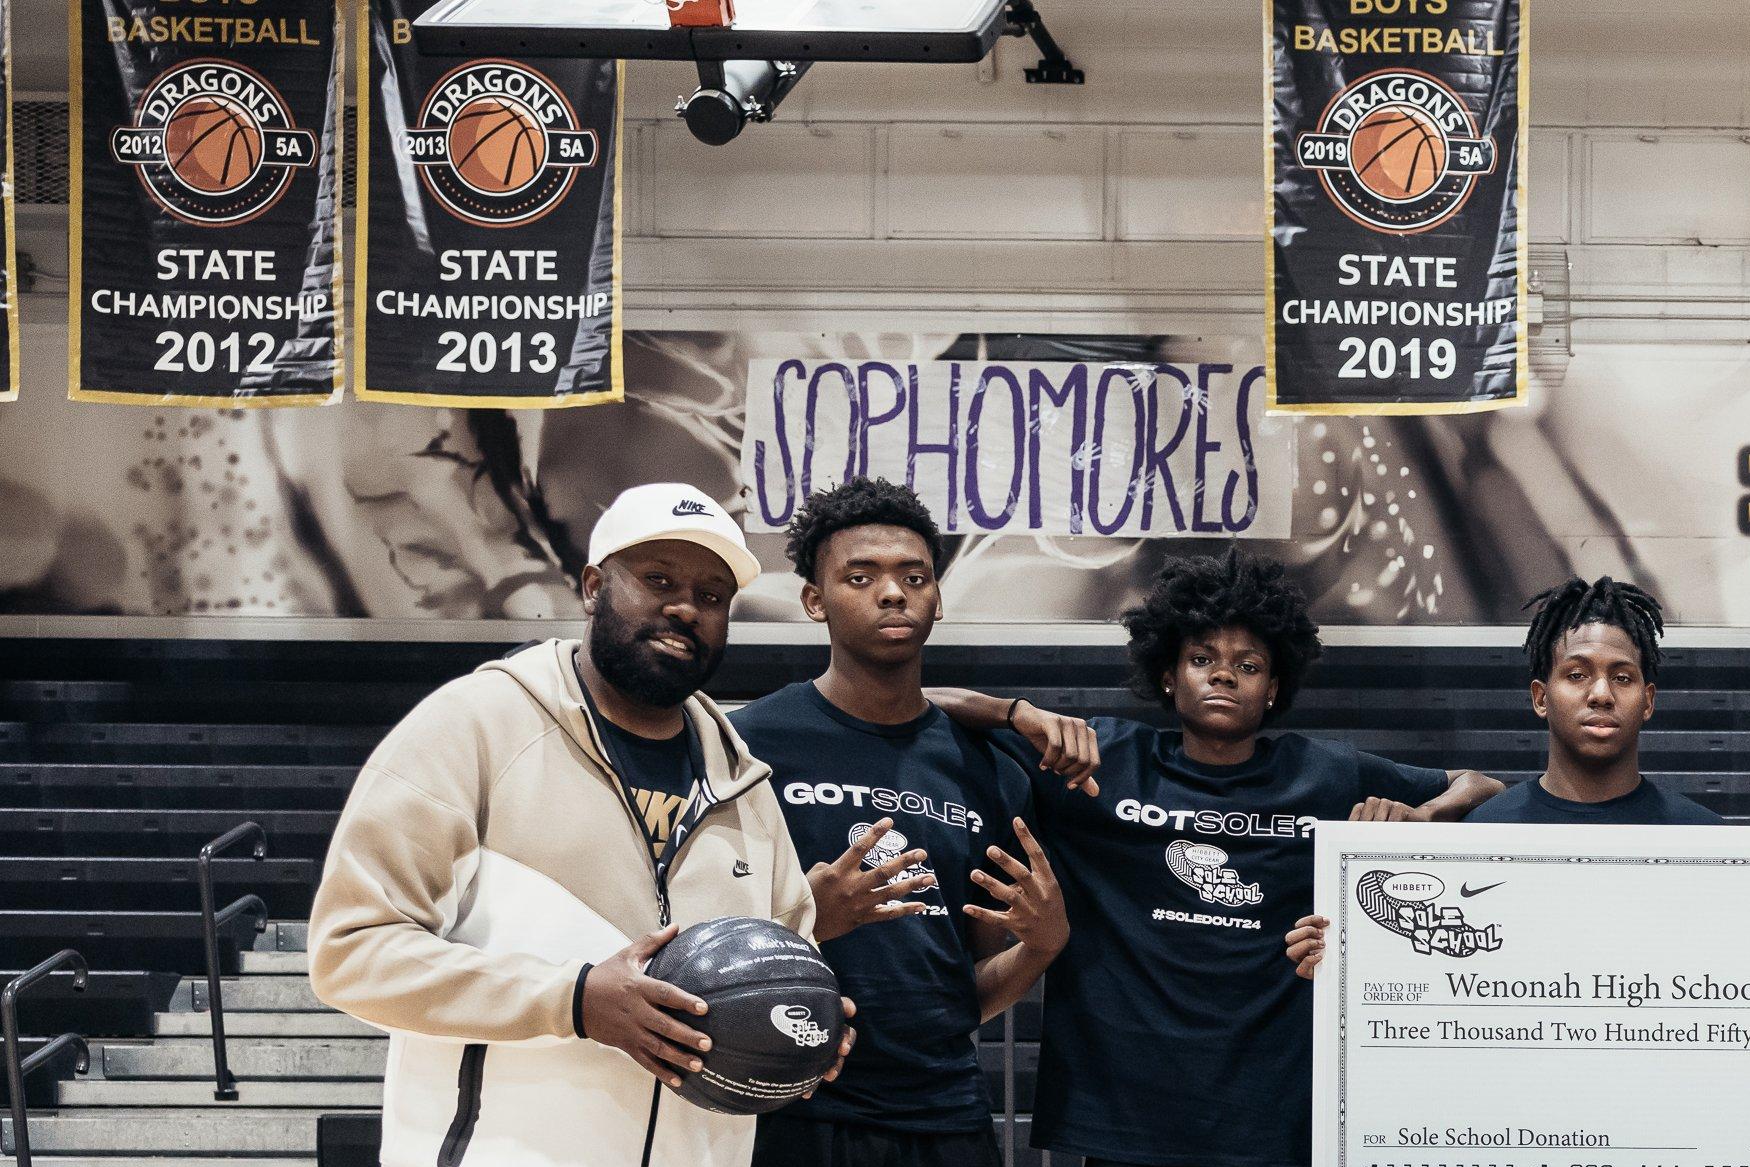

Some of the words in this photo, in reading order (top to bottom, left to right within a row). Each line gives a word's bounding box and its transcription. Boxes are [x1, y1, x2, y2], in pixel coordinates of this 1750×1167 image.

[107, 15, 320, 46] BASKETBALL
[1294, 25, 1504, 56] BASKETBALL
[148, 68, 278, 123] DRAGONS
[430, 69, 563, 125] DRAGONS
[1333, 79, 1463, 133] DRAGONS
[119, 135, 162, 154] 2012
[275, 137, 302, 157] 5A
[404, 136, 446, 156] 2013
[559, 138, 585, 158] 5A
[1303, 141, 1346, 161] 2019
[1459, 147, 1484, 166] 5A
[157, 250, 277, 283] STATE
[440, 250, 558, 282] STATE
[1338, 253, 1457, 289] STATE
[91, 291, 328, 321] CHAMPIONSHIP
[376, 291, 608, 321] CHAMPIONSHIP
[1283, 299, 1512, 326] CHAMPIONSHIP
[153, 331, 276, 374] 2012
[436, 331, 557, 374] 2013
[1338, 336, 1457, 380] 2019
[754, 358, 1266, 535] SOPHOMORES
[678, 499, 706, 512] NIKE
[735, 859, 749, 873] NIKE
[1192, 848, 1221, 856] HIBBETT
[1192, 866, 1239, 885] SOLE
[1392, 883, 1433, 891] HIBBETT
[1201, 882, 1264, 904] SCHOOL
[1152, 908, 1261, 930] #SOLEDOUT24
[1397, 902, 1465, 931] SOLE
[1412, 923, 1504, 956] SCHOOL
[1363, 982, 1384, 992] PAY
[1388, 982, 1404, 992] TO
[1406, 983, 1430, 993] THE
[1363, 992, 1404, 1002] ORDER
[1406, 993, 1422, 1002] OF
[1445, 971, 1581, 999] Wenonah
[1592, 973, 1662, 1008] High
[1367, 1019, 1430, 1041] Three
[1436, 1020, 1543, 1042] Thousand
[1550, 1022, 1597, 1042] Two
[1604, 1021, 1699, 1043] Hundred
[1363, 1134, 1386, 1145] FOR
[1397, 1127, 1439, 1147] Sole
[1445, 1127, 1511, 1147] School
[1517, 1128, 1611, 1148] Donation
